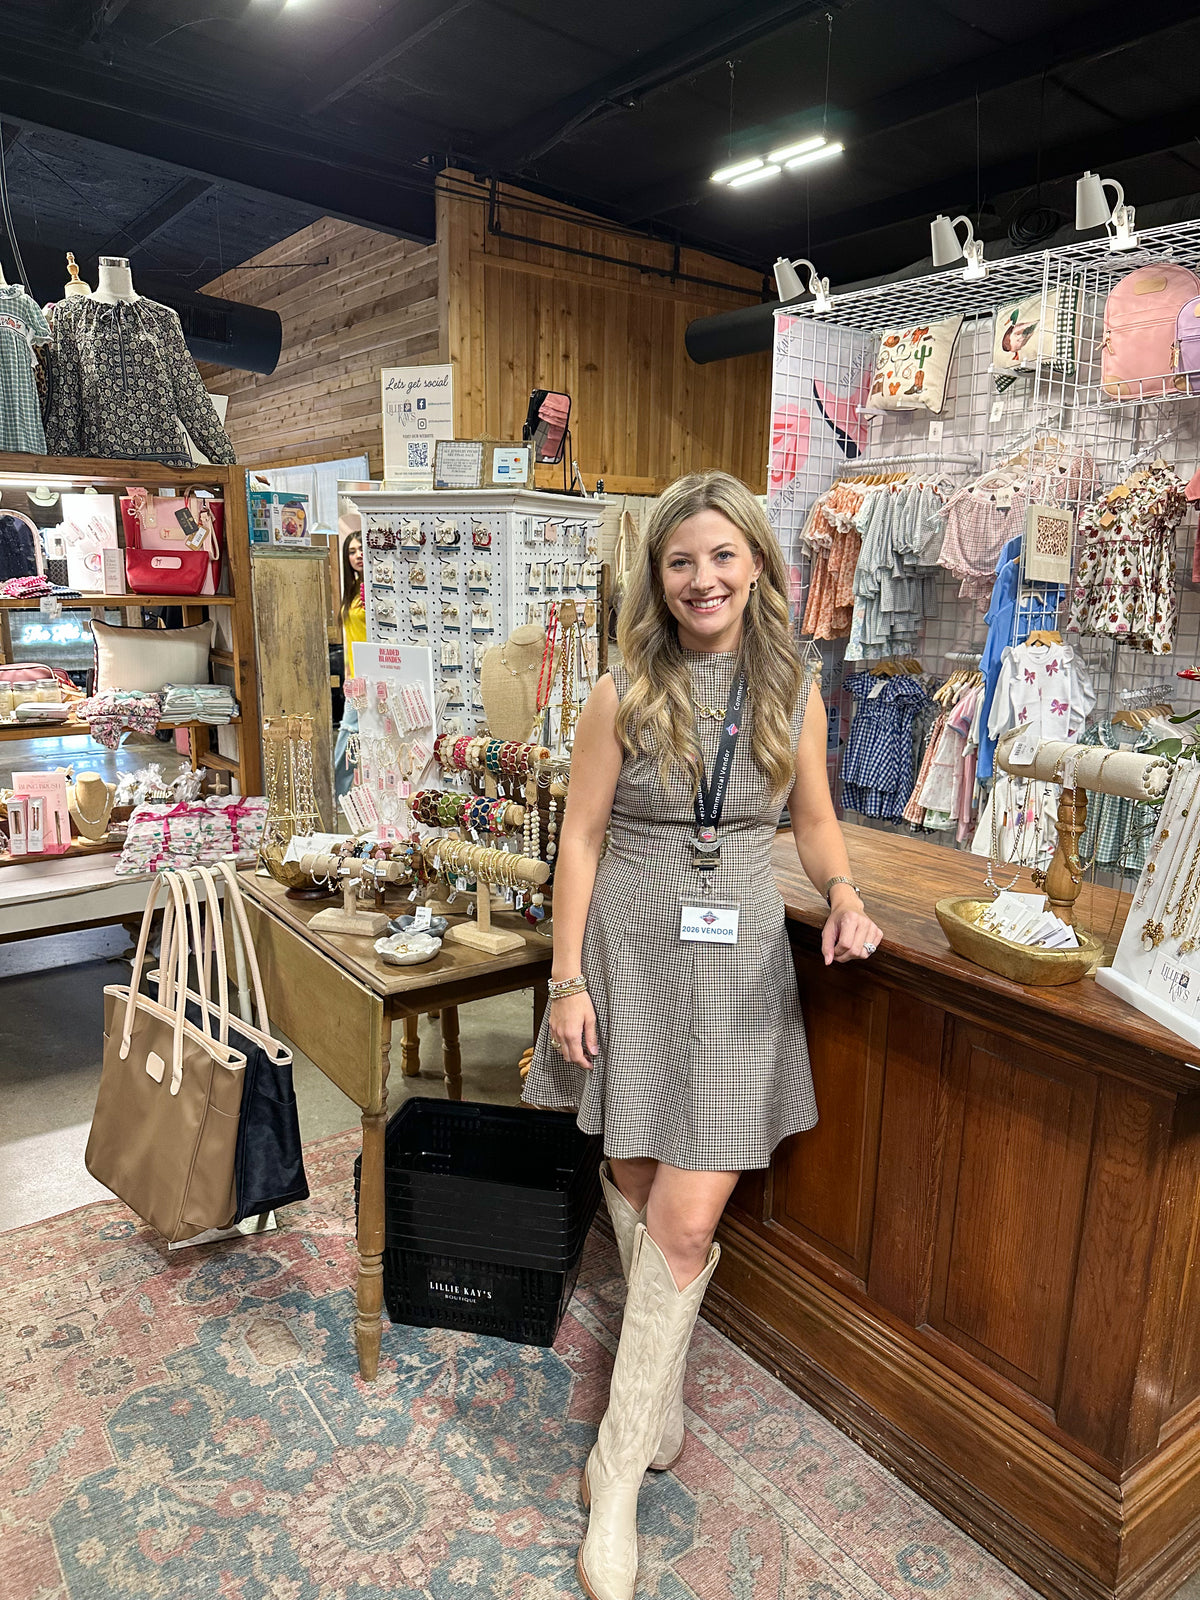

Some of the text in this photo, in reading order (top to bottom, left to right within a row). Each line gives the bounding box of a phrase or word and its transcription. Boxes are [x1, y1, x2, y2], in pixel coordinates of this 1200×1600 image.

[385, 375, 449, 394] Lets get social
[379, 648, 400, 656] BEADED
[378, 655, 402, 663] BLONDES
[710, 749, 731, 819] Commercial Vendor
[682, 925, 734, 936] 2026 VENDOR
[429, 1281, 492, 1299] LILLIE KAY'S
[444, 1294, 477, 1303] BOUTIQUE
